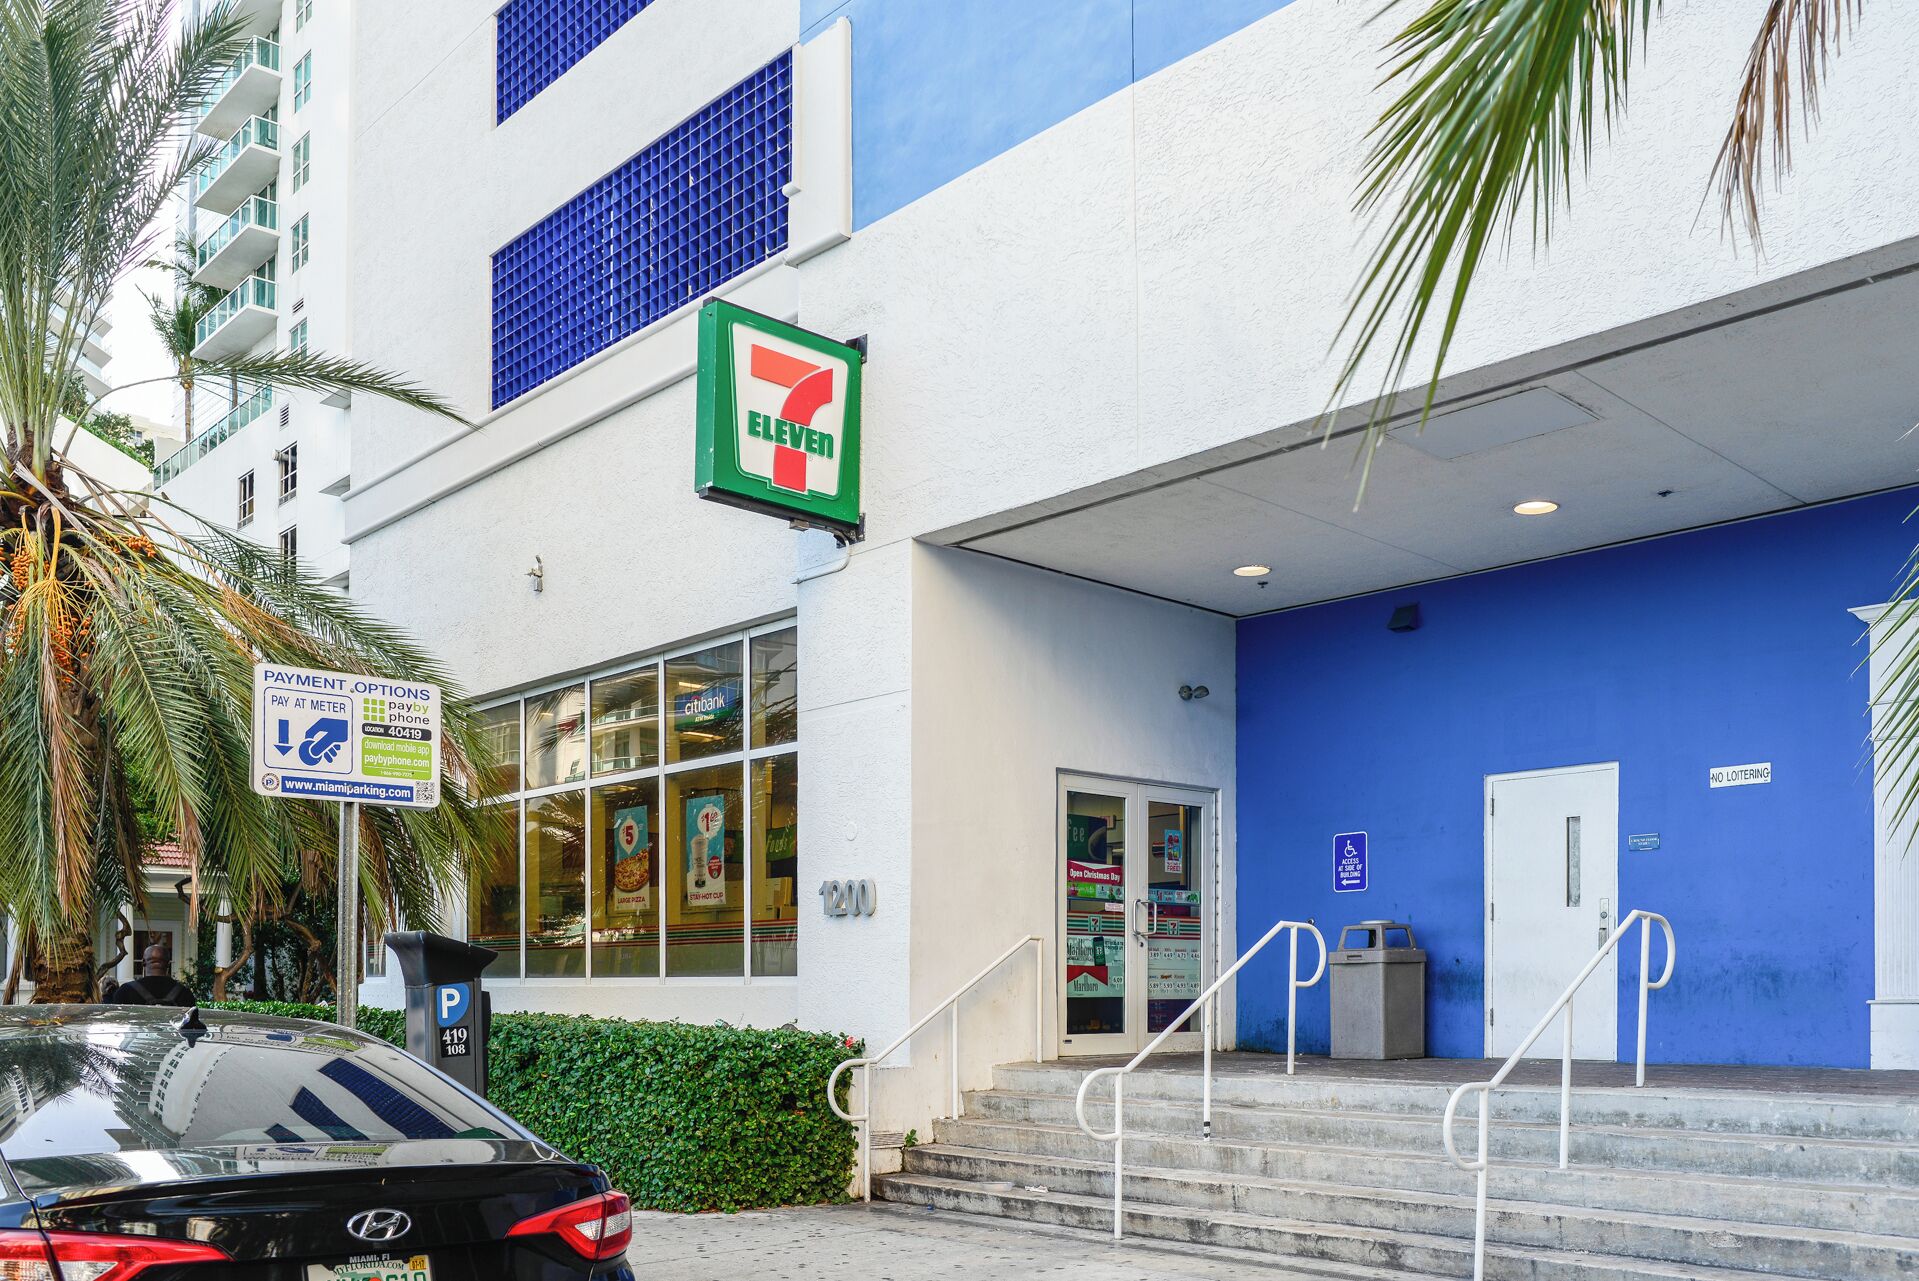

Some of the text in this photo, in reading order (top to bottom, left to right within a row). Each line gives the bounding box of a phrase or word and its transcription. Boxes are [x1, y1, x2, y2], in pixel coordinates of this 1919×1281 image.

[751, 343, 834, 493] 7
[264, 670, 431, 701] PAYMENT OPTIONS
[271, 695, 346, 714] PAY AT METER
[685, 692, 725, 715] citibank
[389, 712, 430, 725] phone
[388, 727, 422, 739] 40419
[364, 740, 430, 756] download mobile app
[364, 755, 430, 768] paybyphone.com
[1712, 767, 1769, 783] NO LOITERING
[285, 779, 411, 798] www.miamiparking.com
[1069, 868, 1121, 882] Open Christmas Day
[819, 879, 877, 917] 1200
[1073, 979, 1099, 992] Marlboro
[441, 988, 460, 1019] P
[442, 1028, 468, 1044] 419
[446, 1044, 466, 1055] 108
[349, 1254, 380, 1264] MIAMI,
